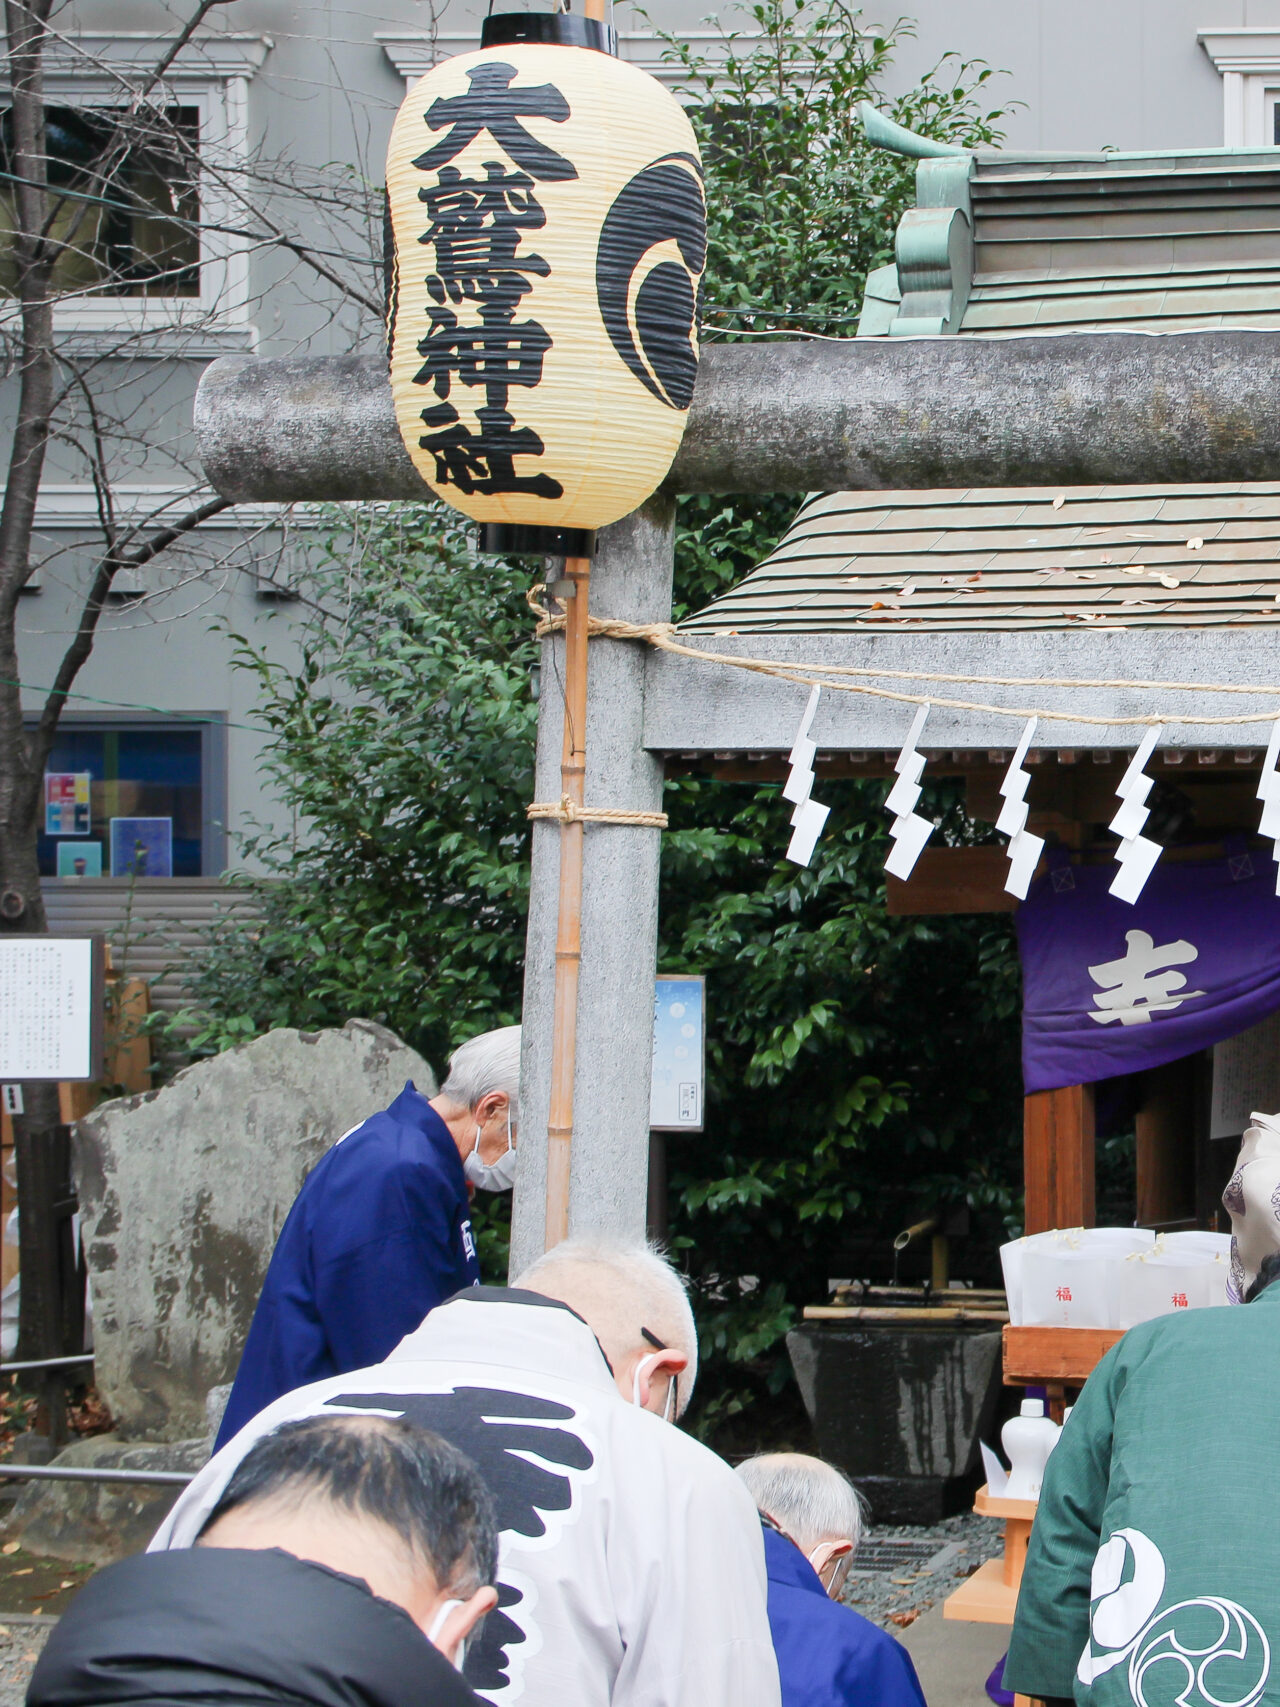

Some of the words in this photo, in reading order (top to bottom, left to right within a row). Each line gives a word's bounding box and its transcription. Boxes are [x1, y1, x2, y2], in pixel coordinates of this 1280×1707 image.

[411, 62, 579, 500] 大鷲神社
[1056, 1286, 1073, 1302] 福
[1171, 1292, 1189, 1308] 福
